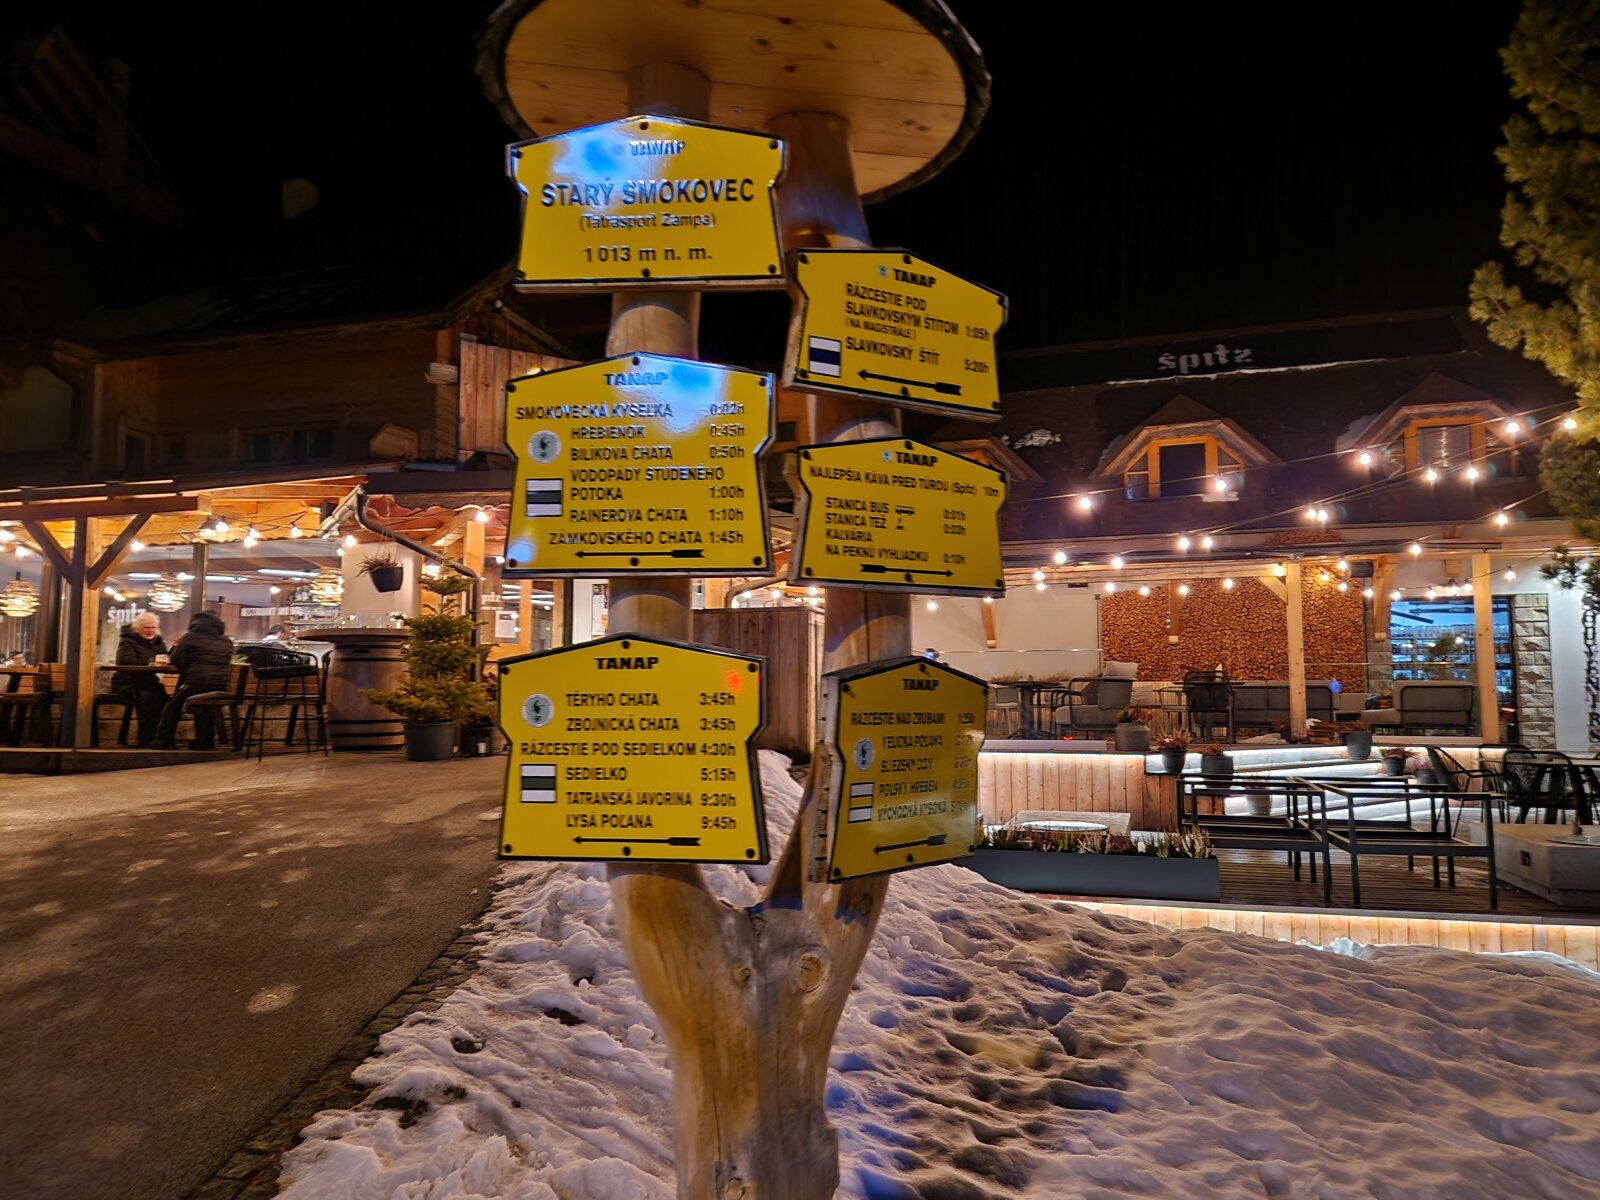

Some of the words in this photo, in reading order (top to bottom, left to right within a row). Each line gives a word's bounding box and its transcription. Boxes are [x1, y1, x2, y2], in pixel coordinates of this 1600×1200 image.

[541, 176, 613, 207] STARÝ
[622, 178, 755, 205] SMOKOVEC
[579, 213, 657, 232] (Tatrasport
[661, 212, 716, 230] Zampa)
[638, 248, 657, 262] m
[663, 248, 681, 261] n.
[688, 247, 713, 260] m.
[893, 267, 937, 289] TANAP
[845, 281, 903, 307] RÁZCESTIE
[905, 295, 927, 312] POD
[845, 300, 922, 328] SLAVKOVSKÝM
[924, 313, 959, 336] ŠTÍTOM
[845, 335, 914, 361] SLAVKOVSKÝ
[604, 372, 669, 386] TANAP
[516, 401, 609, 420] SMOKOVECKÁ
[571, 425, 646, 440] HREBIENOK
[709, 424, 745, 438] 0:45h
[570, 444, 628, 461] BILÍKOVÁ
[632, 446, 674, 460] CHATA
[895, 451, 938, 468] TANAP
[570, 465, 640, 483] VODOPÁDY
[645, 464, 725, 482] STUDENÉHO
[809, 465, 863, 483] NAJLEPŠIA
[864, 470, 890, 486] KÁVA
[892, 475, 917, 488] PRED
[570, 486, 624, 501] POTOKA
[709, 485, 744, 499] 1:00h
[825, 496, 867, 512] STANICA
[869, 501, 890, 514] BUS
[570, 509, 643, 523] RAINEROVA
[647, 508, 688, 522] CHATA
[709, 508, 744, 521] 1:10h
[824, 513, 867, 528] STANICA
[548, 529, 654, 545] ZÁMKOVSKÉHO
[659, 531, 703, 544] CHATA
[709, 531, 744, 544] 1:45h
[825, 528, 873, 543] KALVÁRIA
[825, 544, 840, 556] NA
[595, 657, 658, 670] TANAP
[903, 678, 939, 691] TANAP
[566, 691, 616, 707] TÉRYHO
[619, 692, 660, 707] CHATA
[699, 692, 736, 706] 3:45h
[566, 714, 635, 732] ZBOJNICKÁ
[639, 717, 680, 731] CHATA
[699, 717, 736, 731] 3:45h
[521, 740, 588, 756] RÁZCESTIE
[592, 742, 619, 756] POD
[623, 742, 697, 756] SEDIELKOM
[700, 743, 736, 757] 4:30h
[566, 766, 628, 781] SEDIELKO
[700, 767, 736, 781] 5:15h
[566, 788, 632, 806] TATRANSKÁ
[636, 792, 693, 806] JAVORINA
